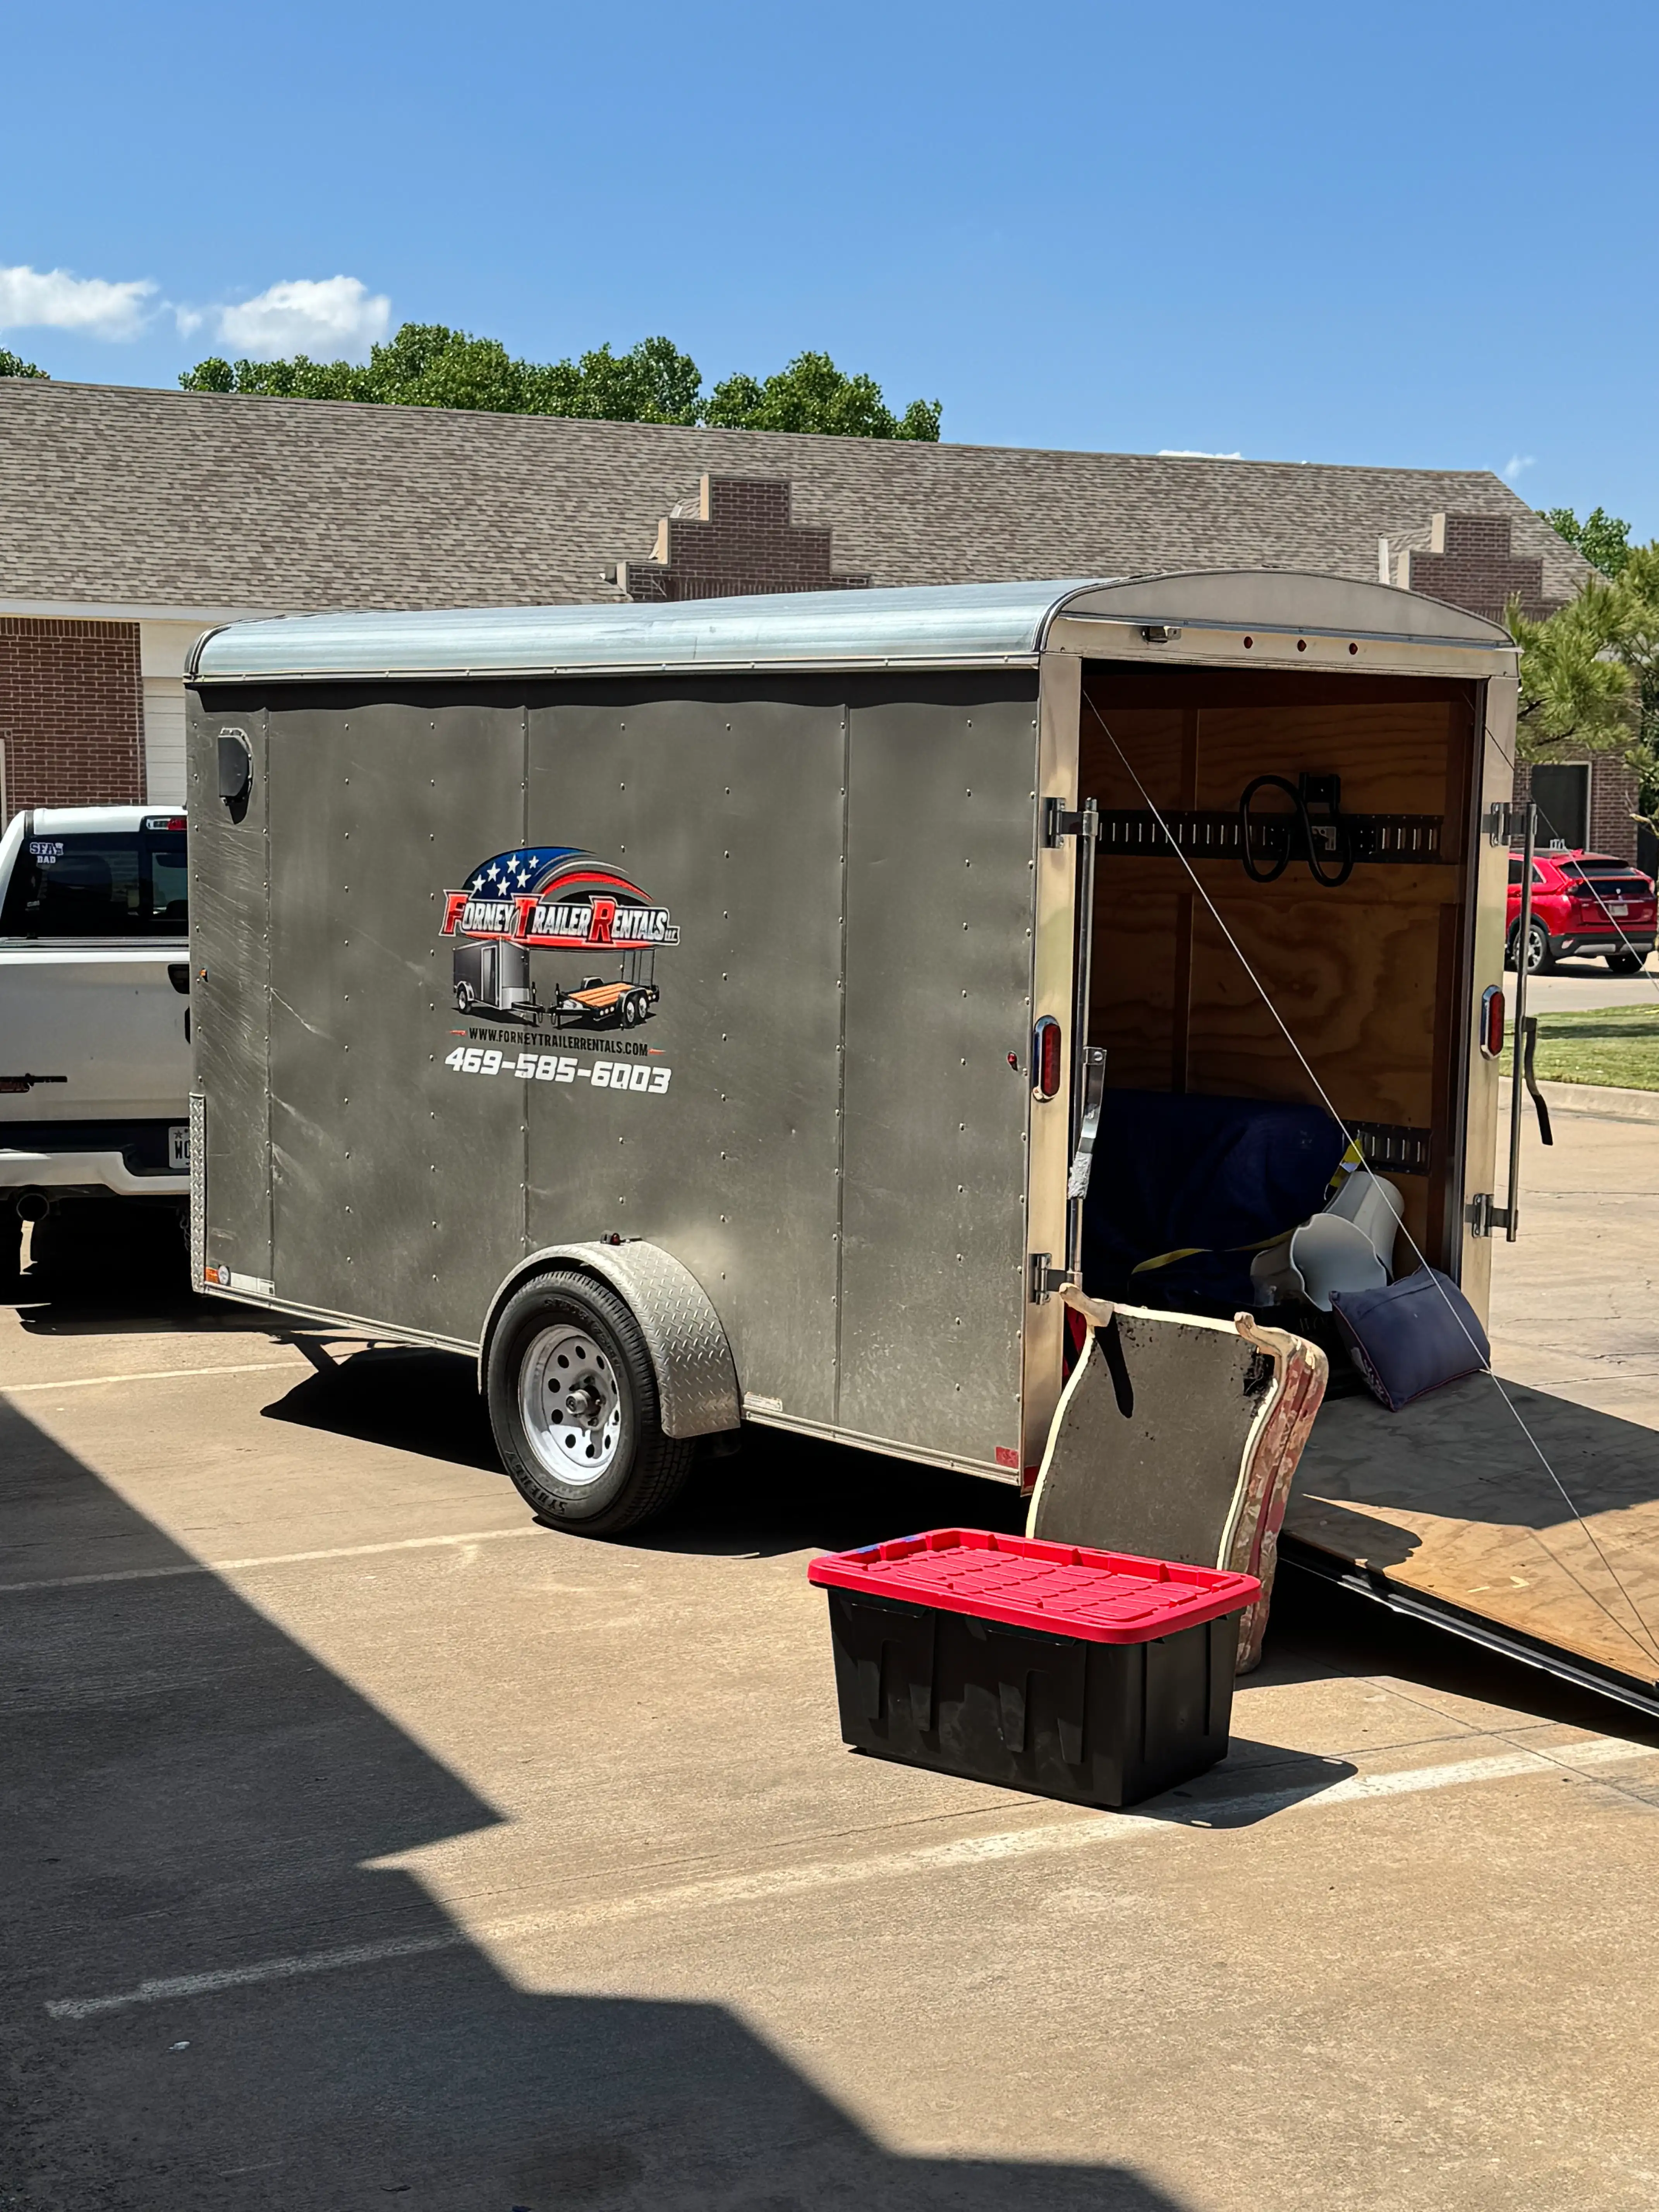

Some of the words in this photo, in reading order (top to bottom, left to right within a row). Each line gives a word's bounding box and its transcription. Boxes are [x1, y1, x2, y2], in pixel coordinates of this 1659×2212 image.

[37, 855, 56, 864] DAD
[441, 892, 516, 935] FORNEY
[513, 896, 591, 938] TRAILER
[588, 898, 668, 943] RENTALS
[664, 929, 678, 941] LLC
[469, 1027, 648, 1056] WWW.FORNEYTRAILERRENTALS.COM
[445, 1046, 672, 1094] 469-585-6003
